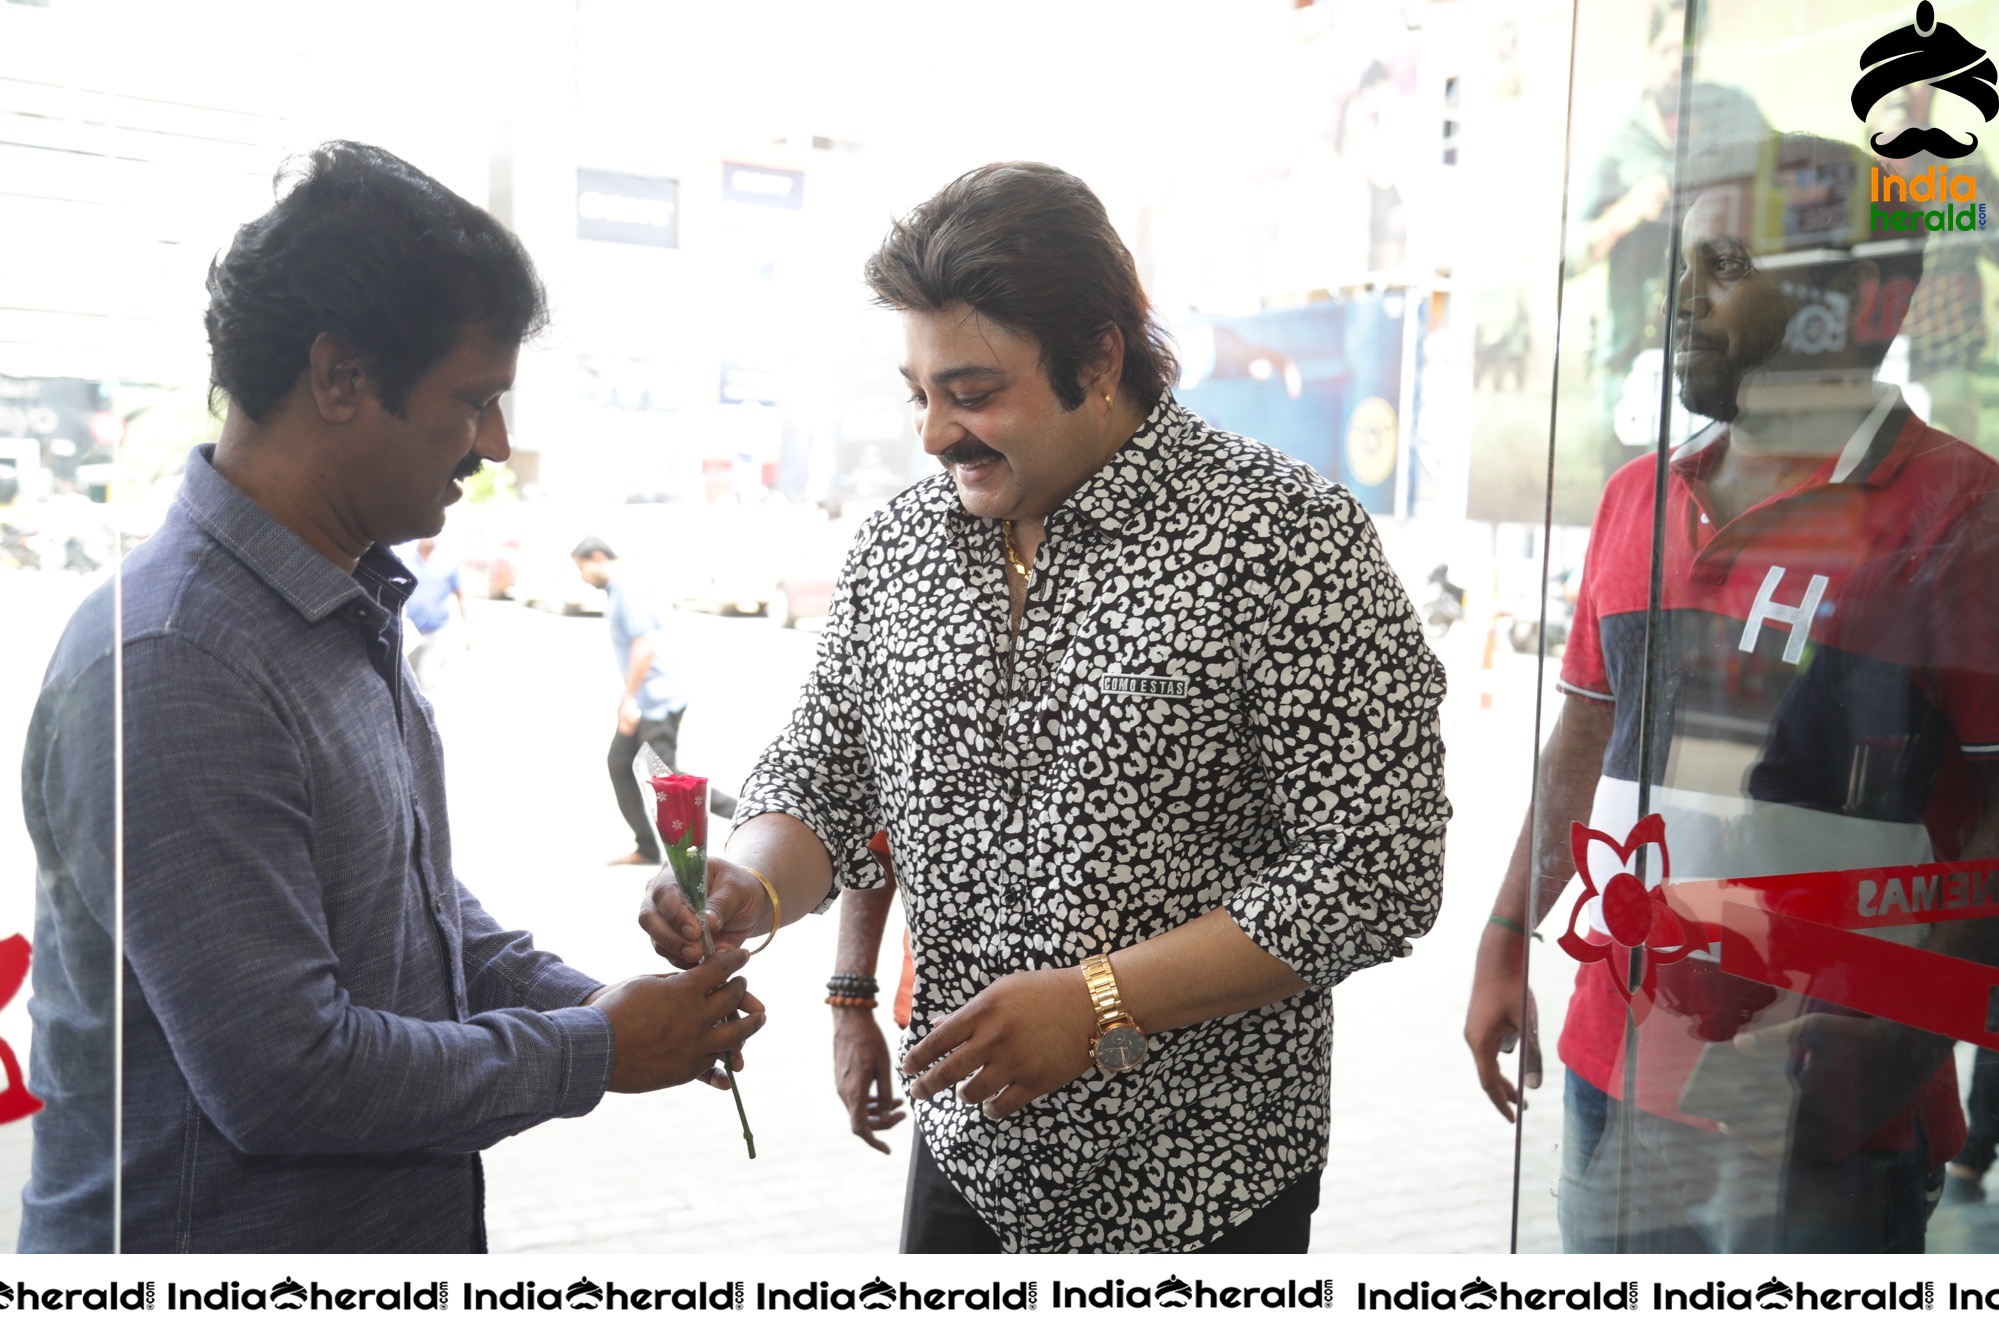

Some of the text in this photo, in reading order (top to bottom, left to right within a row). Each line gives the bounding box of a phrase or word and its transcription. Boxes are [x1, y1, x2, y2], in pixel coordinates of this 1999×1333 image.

[1739, 566, 1829, 664] H
[1104, 677, 1184, 695] COMO ESTAS
